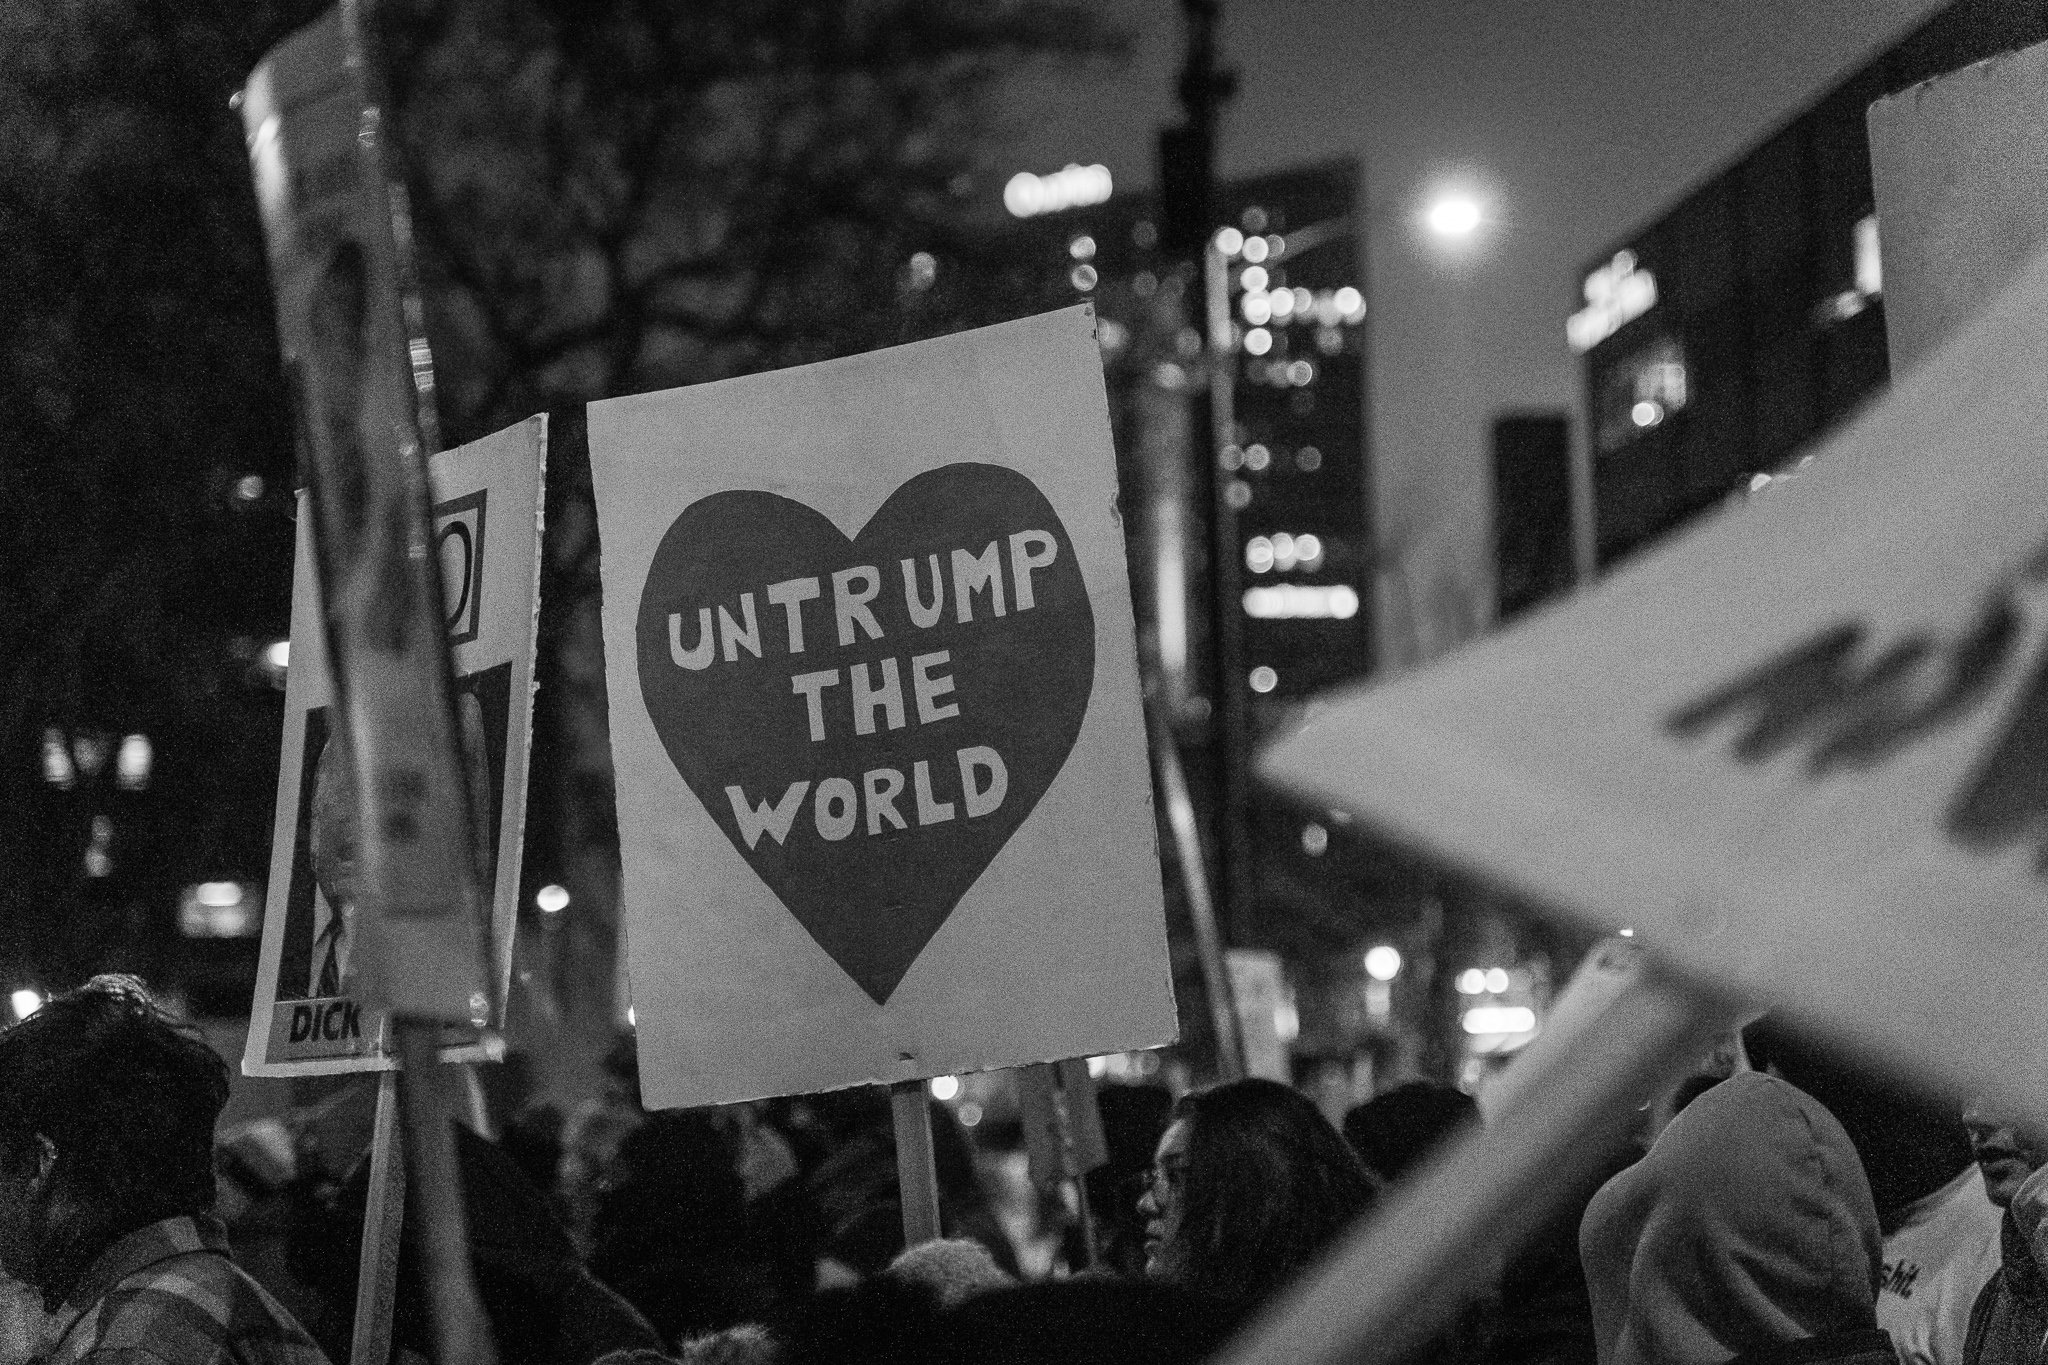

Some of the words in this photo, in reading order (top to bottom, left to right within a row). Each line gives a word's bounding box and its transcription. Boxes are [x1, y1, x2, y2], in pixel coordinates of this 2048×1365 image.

[668, 529, 1058, 671] UNTRUMP
[791, 649, 960, 742] THE
[724, 745, 1009, 851] WORLD
[289, 1001, 361, 1043] DICK
